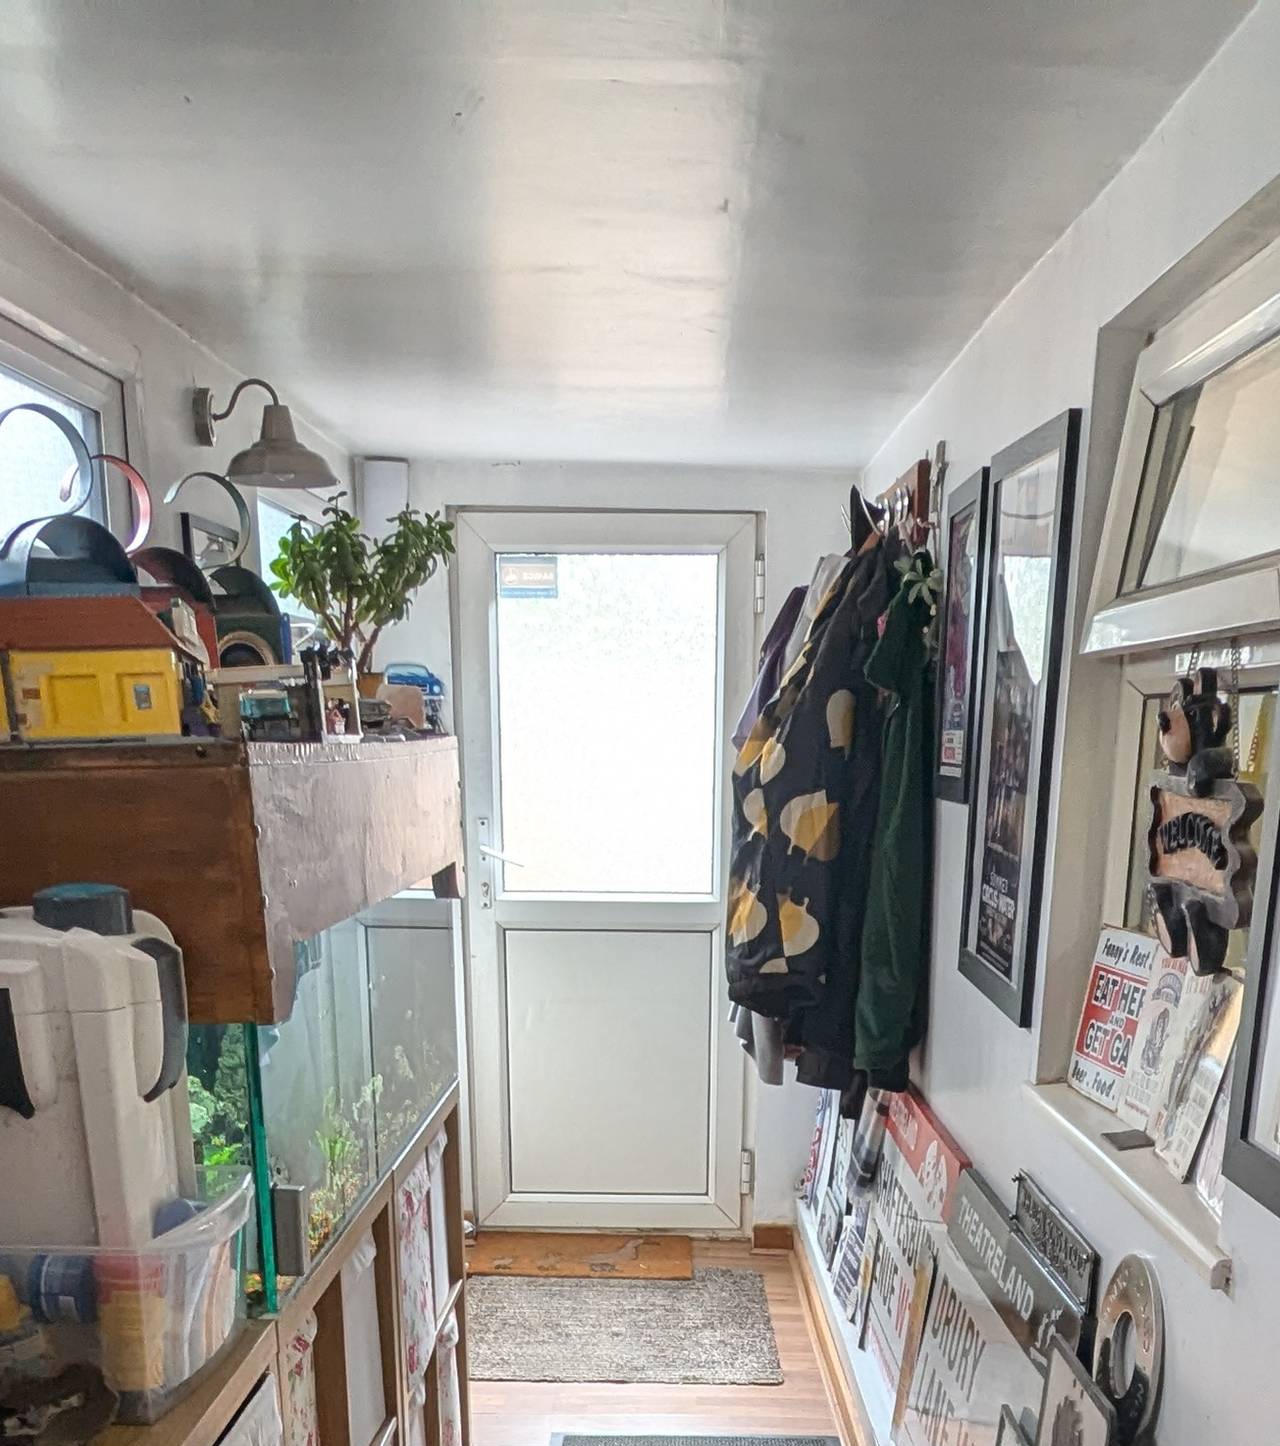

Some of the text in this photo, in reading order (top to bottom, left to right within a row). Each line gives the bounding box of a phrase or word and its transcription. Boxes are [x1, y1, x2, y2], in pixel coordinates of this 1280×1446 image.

[1102, 937, 1131, 965] Fanny's
[1093, 973, 1119, 1010] EAT
[1085, 1021, 1132, 1070] GET GA
[1110, 1013, 1125, 1030] AND
[873, 1229, 899, 1318] ENUE
[958, 1194, 1035, 1321] THEATRELAND
[931, 1274, 986, 1403] DRURY
